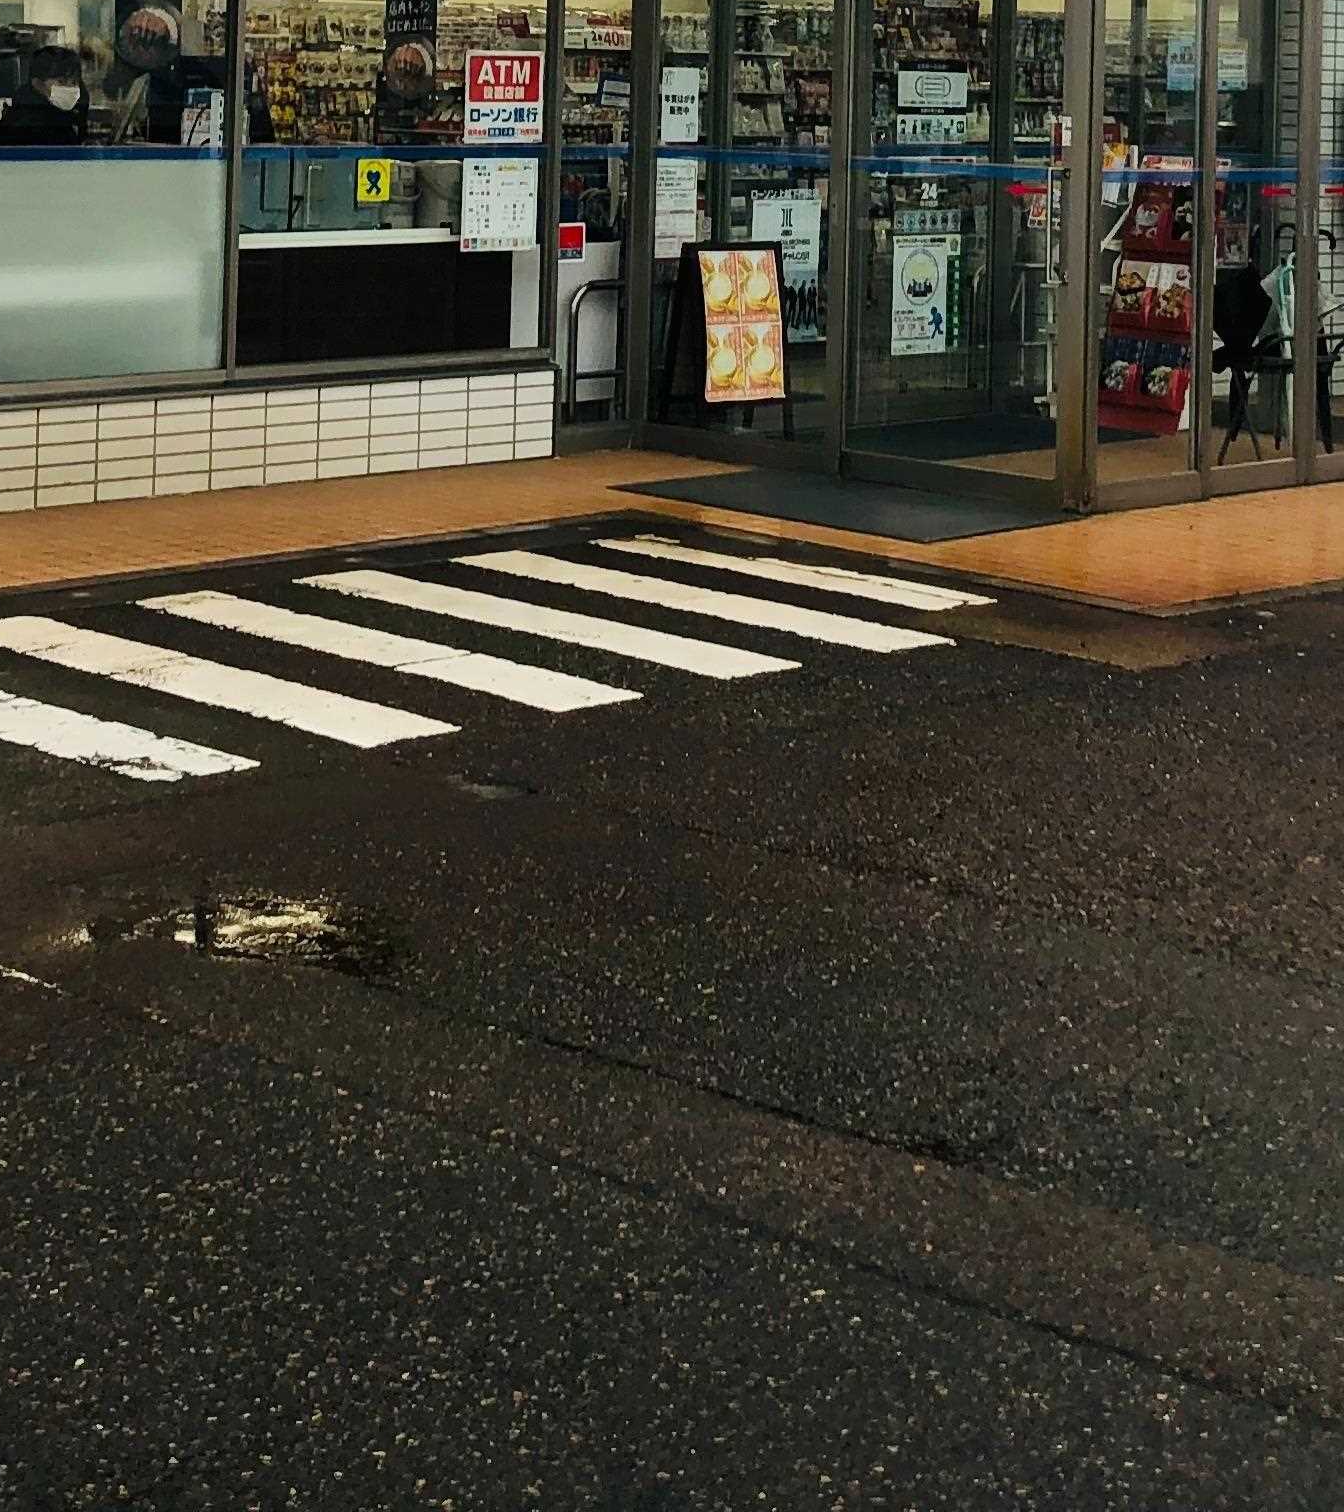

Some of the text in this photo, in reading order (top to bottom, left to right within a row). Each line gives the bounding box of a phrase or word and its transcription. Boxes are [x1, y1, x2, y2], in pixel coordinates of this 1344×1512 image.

[477, 60, 531, 85] ATM
[470, 107, 538, 123] ローソン銀行
